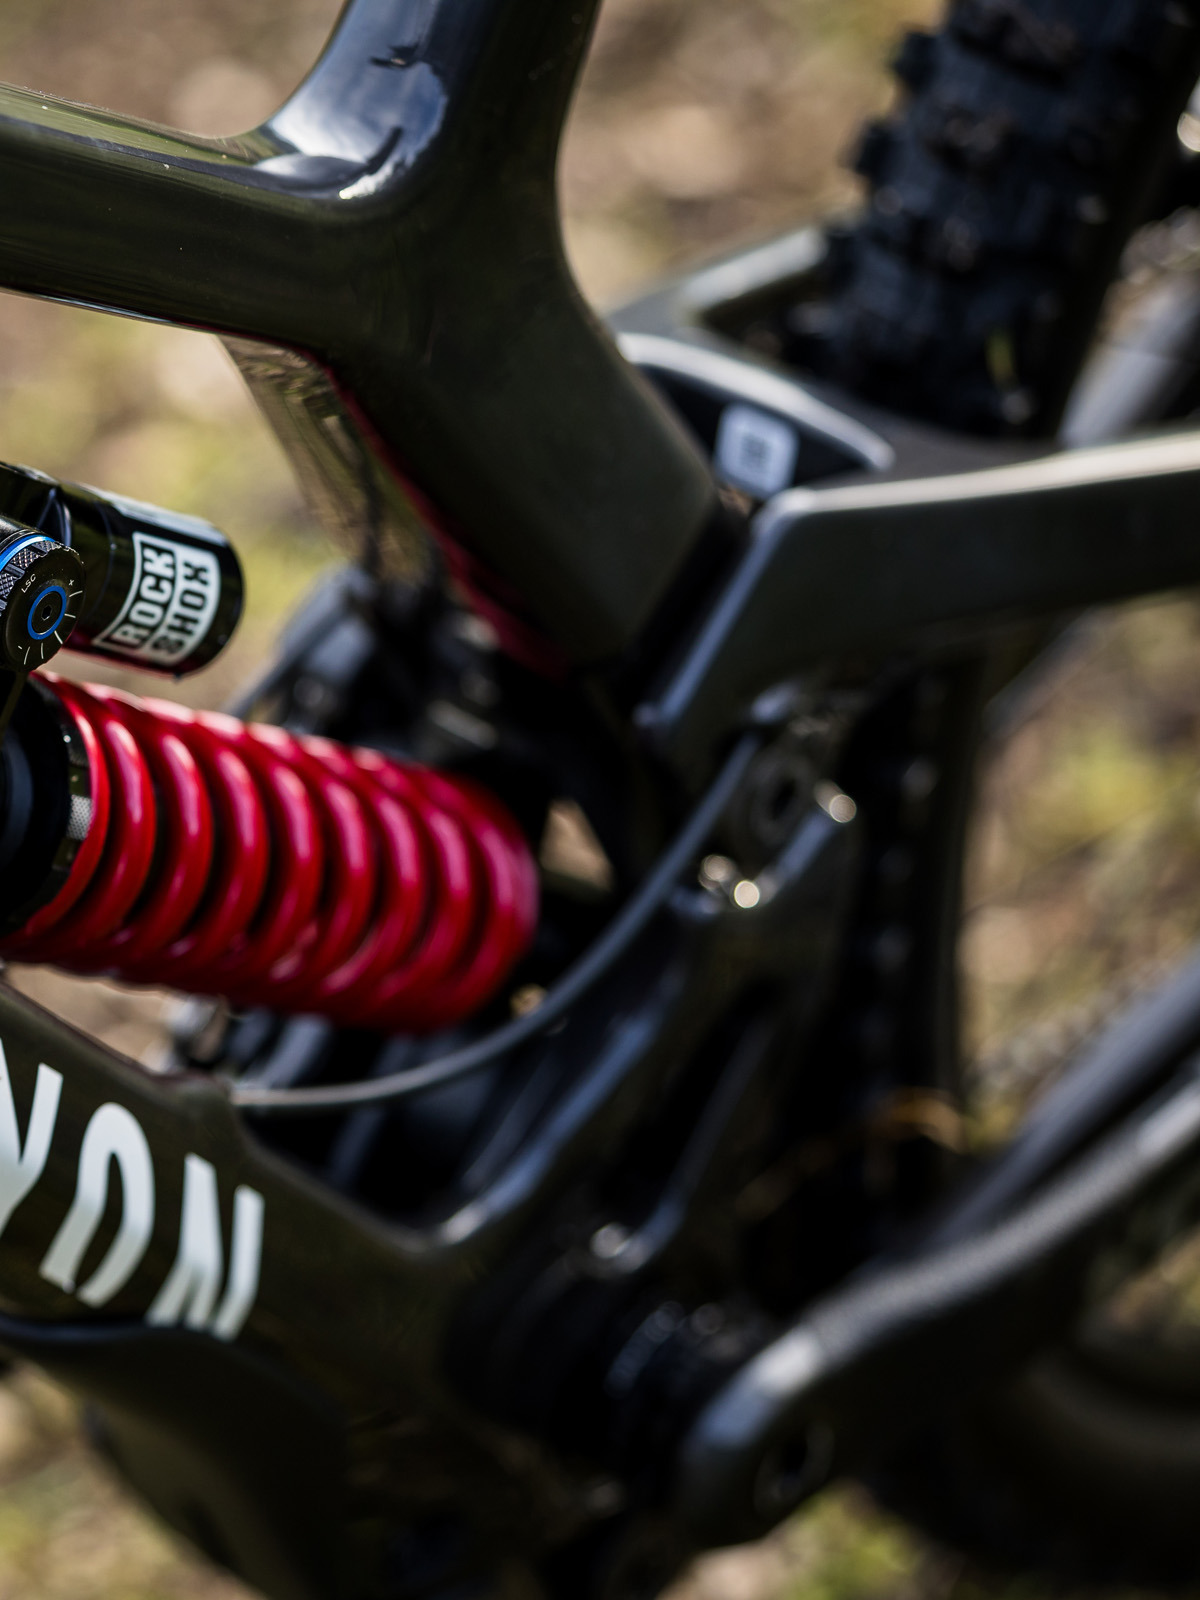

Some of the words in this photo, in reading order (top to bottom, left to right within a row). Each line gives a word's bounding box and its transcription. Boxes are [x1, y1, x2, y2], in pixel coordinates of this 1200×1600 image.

[21, 573, 37, 594] LSC
[110, 547, 176, 645] ROCK
[151, 560, 210, 655] SHOX
